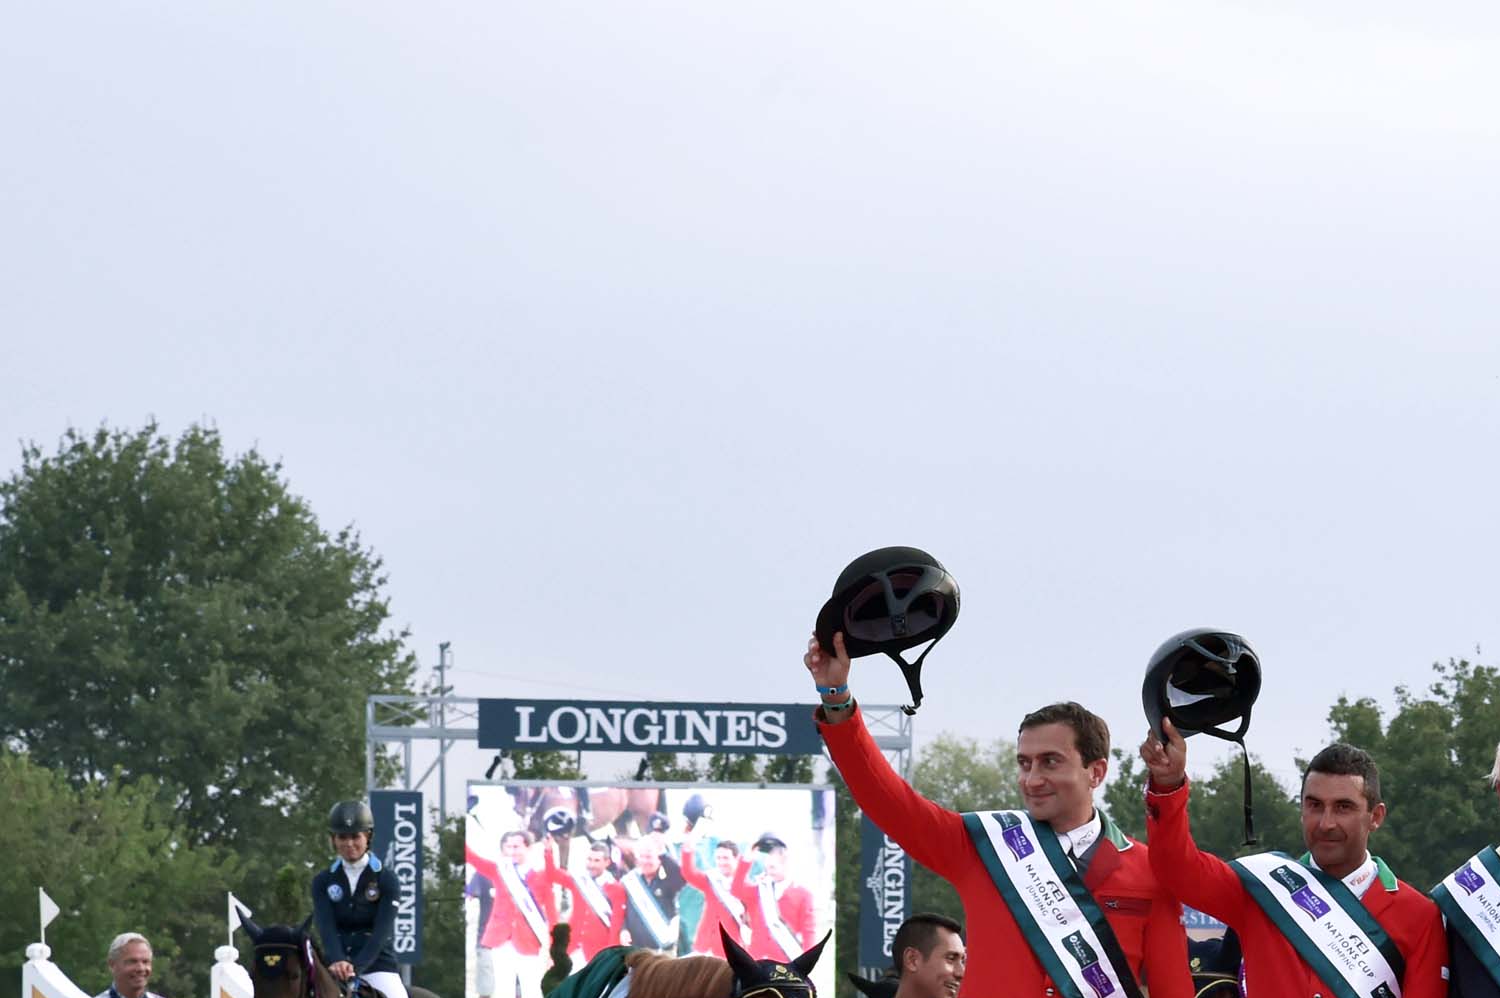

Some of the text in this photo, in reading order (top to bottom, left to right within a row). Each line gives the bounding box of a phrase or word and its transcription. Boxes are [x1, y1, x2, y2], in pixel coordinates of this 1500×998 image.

[515, 706, 787, 748] LONGINES
[394, 802, 416, 953] LONGINES
[1025, 864, 1067, 926] NATIONS CUP
[1324, 921, 1374, 978] NATIONS CUP
[1328, 942, 1355, 971] JUMPING
